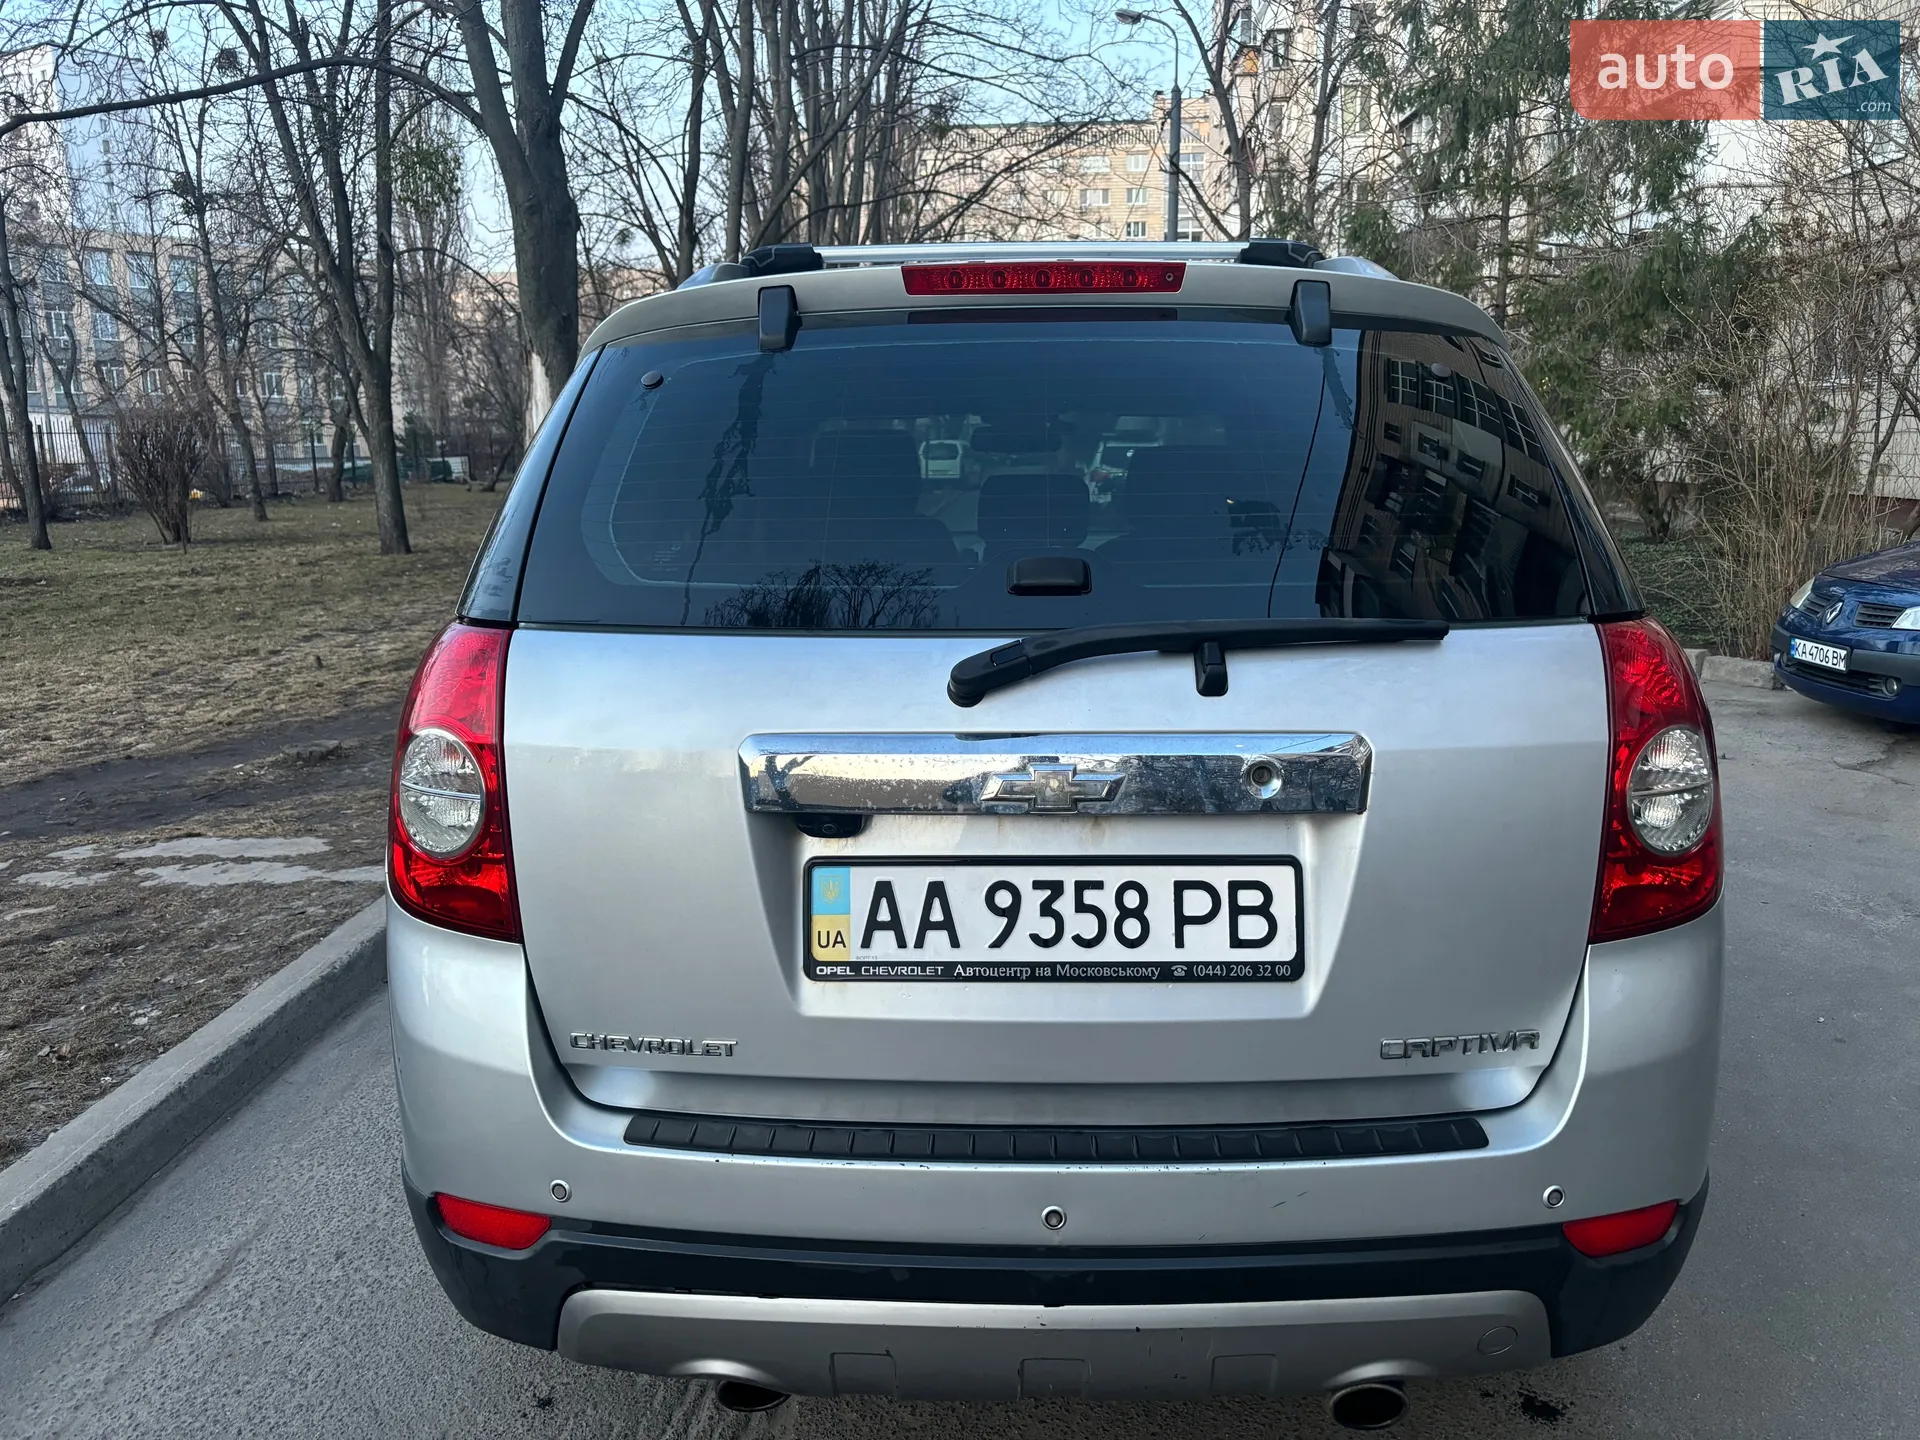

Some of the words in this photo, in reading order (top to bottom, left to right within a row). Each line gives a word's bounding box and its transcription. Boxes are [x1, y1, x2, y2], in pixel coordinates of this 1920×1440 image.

[1808, 645, 1830, 664] 4706
[860, 880, 961, 949] AA
[984, 879, 1150, 949] 9358
[1173, 879, 1278, 949] PB
[817, 930, 847, 949] UA
[816, 965, 855, 976] OPEL
[861, 965, 944, 976] CHEVROLET
[953, 964, 1031, 980] Автоцентр
[1035, 966, 1052, 977] на
[1056, 963, 1161, 981] Московському
[1193, 963, 1226, 978] (044)
[1230, 964, 1253, 977] 206
[1256, 964, 1272, 977] 32
[1275, 964, 1291, 977] 00
[569, 1031, 738, 1057] CHEVROLET
[1380, 1029, 1541, 1060] CAPTIVA
